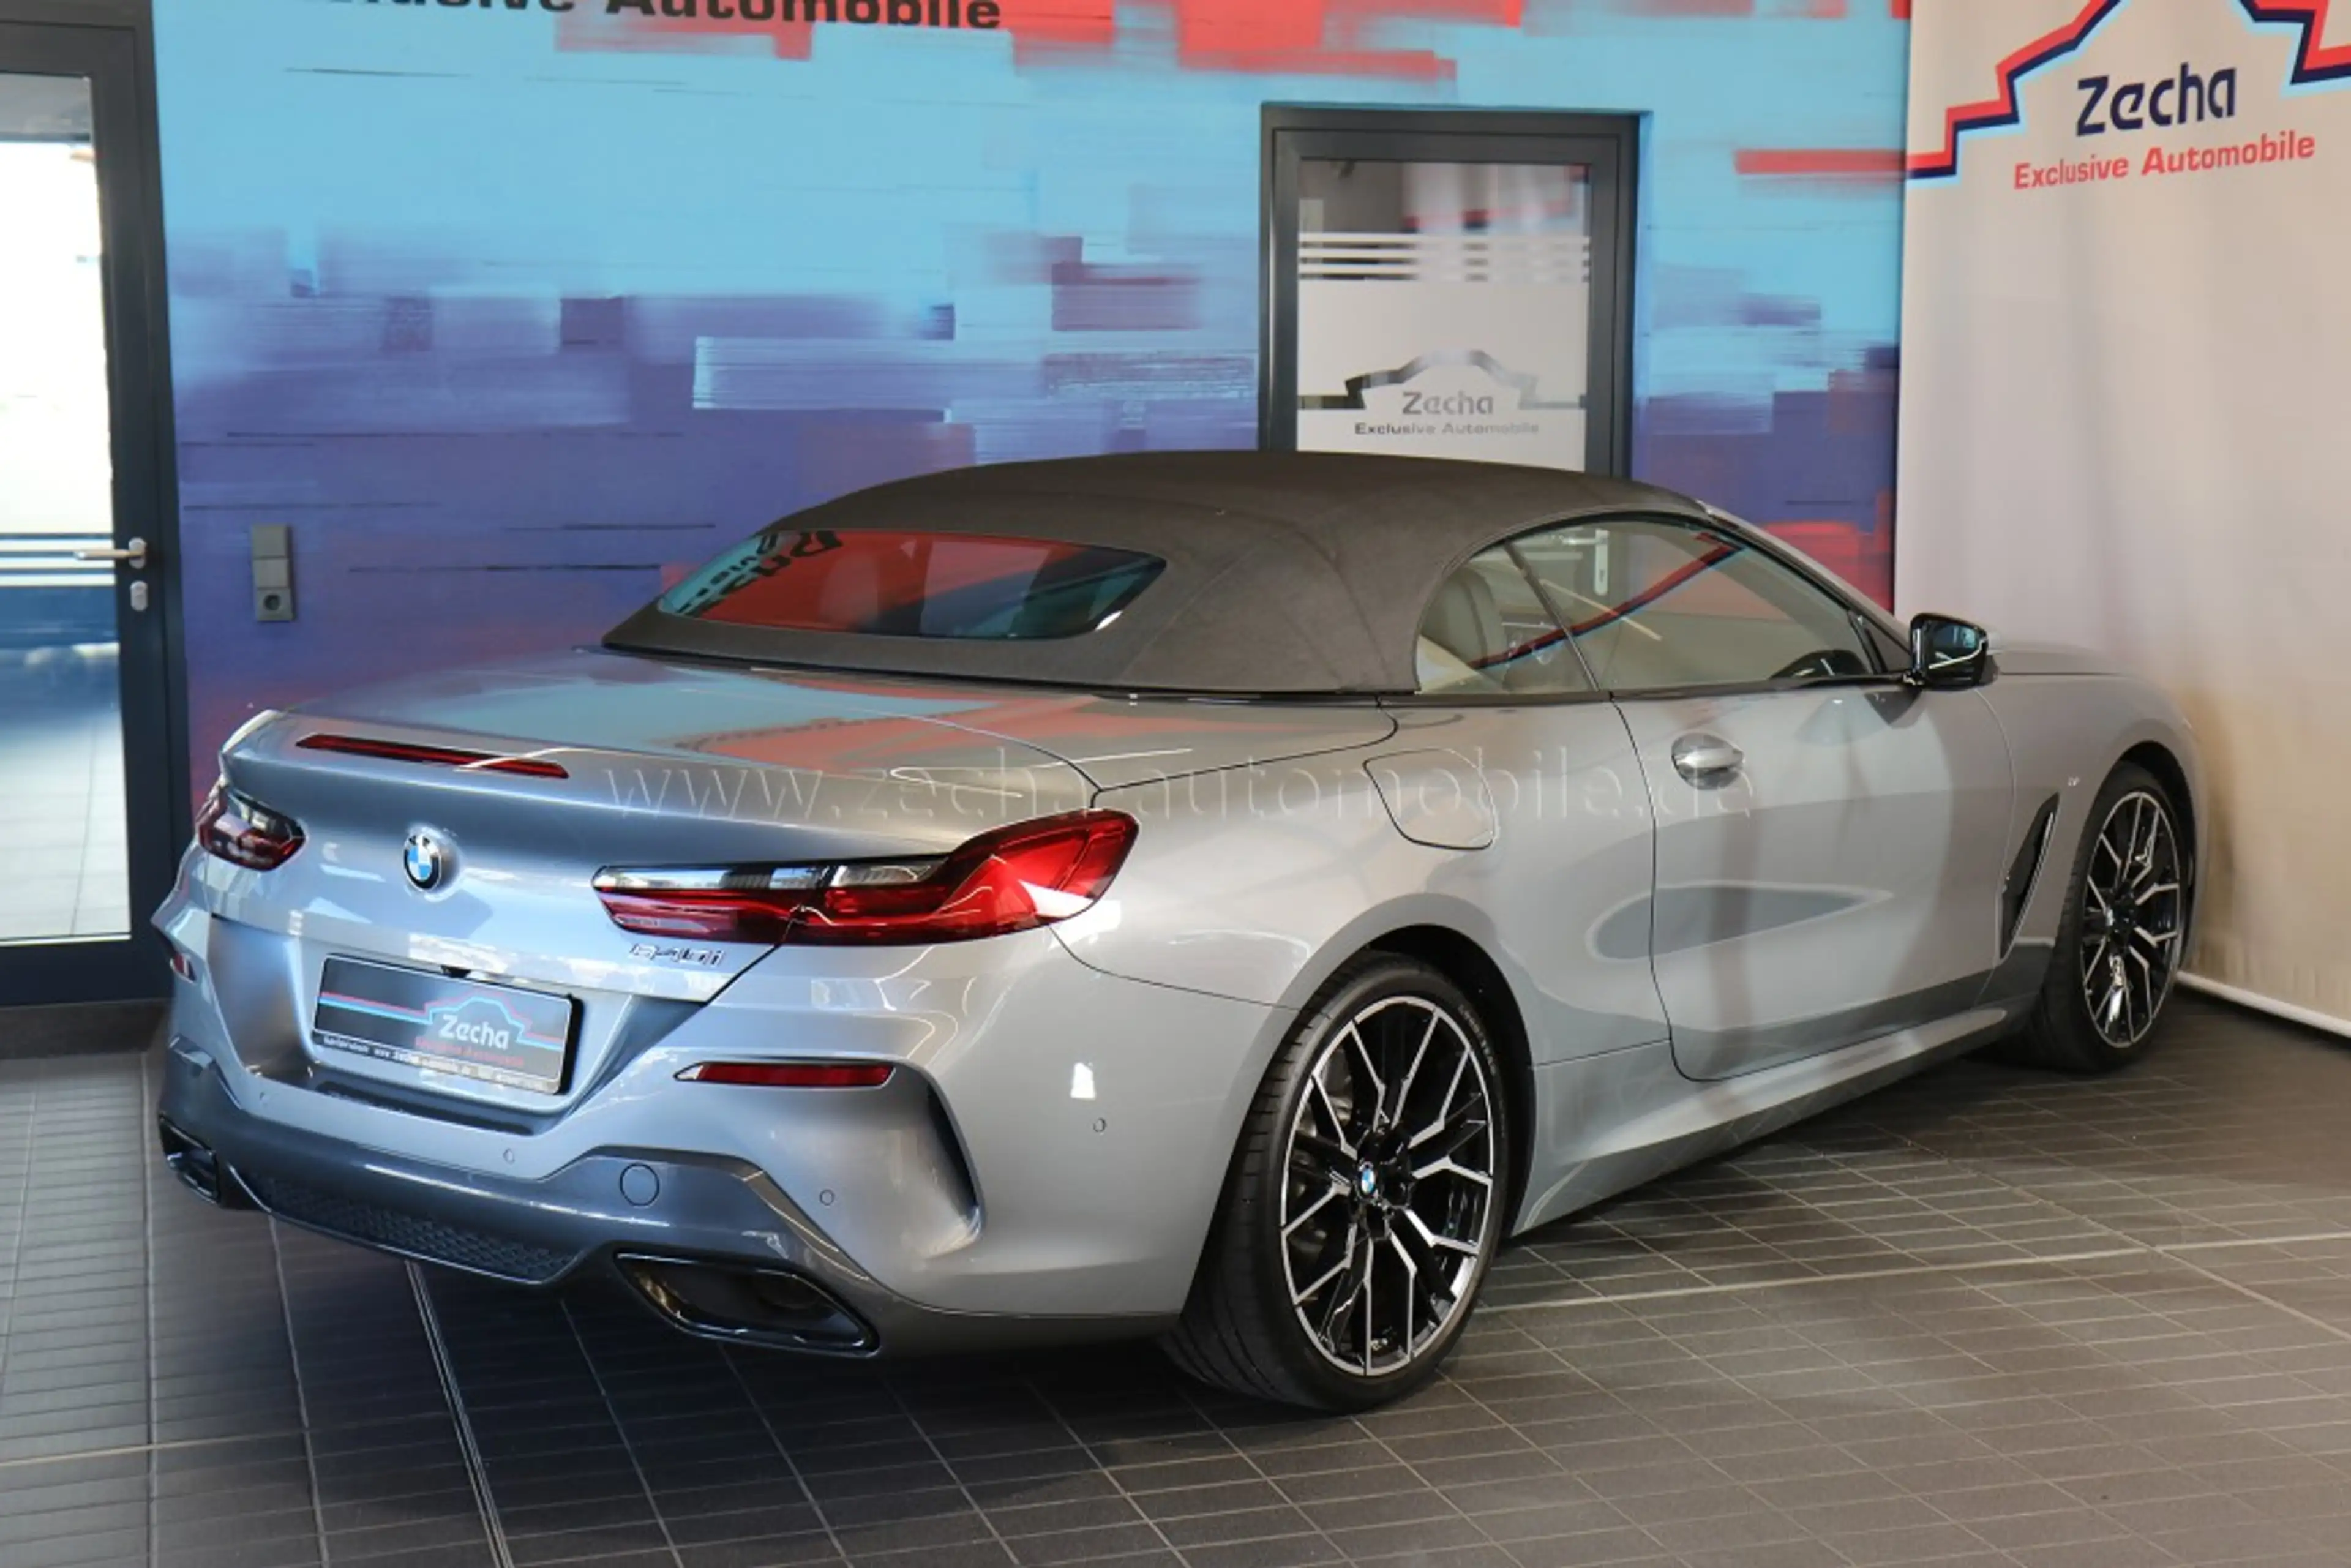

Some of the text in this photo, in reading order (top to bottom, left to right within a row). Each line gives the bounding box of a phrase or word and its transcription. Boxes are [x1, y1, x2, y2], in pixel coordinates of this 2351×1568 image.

[2075, 62, 2237, 137] Zecha
[2014, 130, 2315, 190] Exclusive Automobile
[1402, 390, 1494, 415] Zecha
[1354, 422, 1539, 435] Exclusive Automobile
[438, 1013, 509, 1051] Zecha
